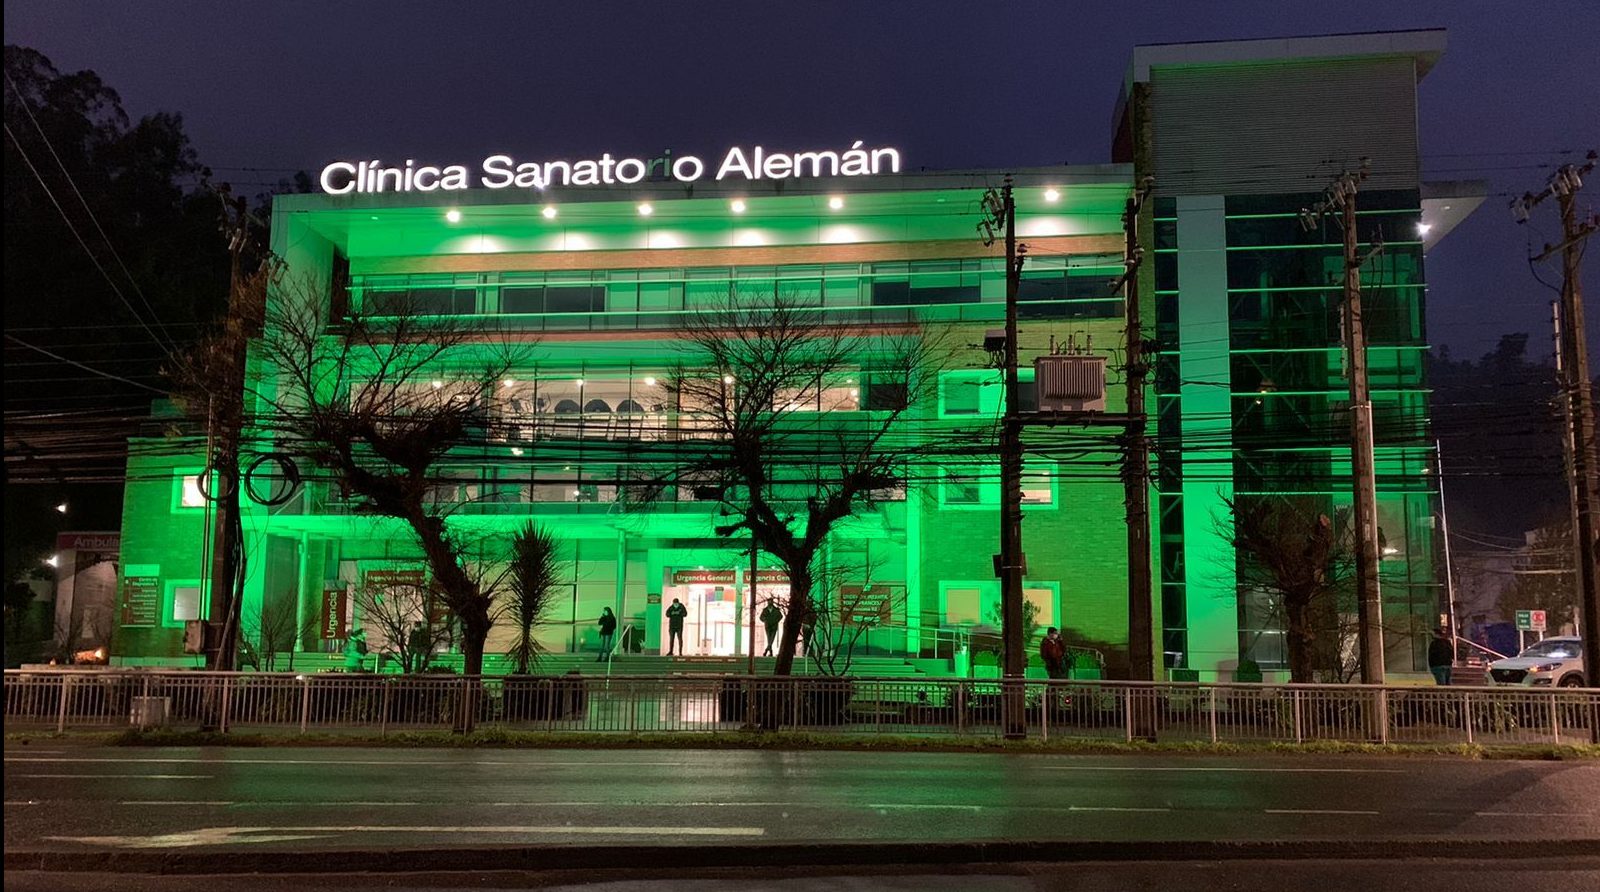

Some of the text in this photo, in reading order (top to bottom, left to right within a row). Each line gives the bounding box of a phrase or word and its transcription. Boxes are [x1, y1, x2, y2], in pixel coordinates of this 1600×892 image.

[321, 140, 900, 193] Clínica Sanatorio Alemán
[676, 574, 734, 583] Urgencia General
[746, 574, 775, 583] Ugencia
[326, 591, 339, 638] Urgencia
